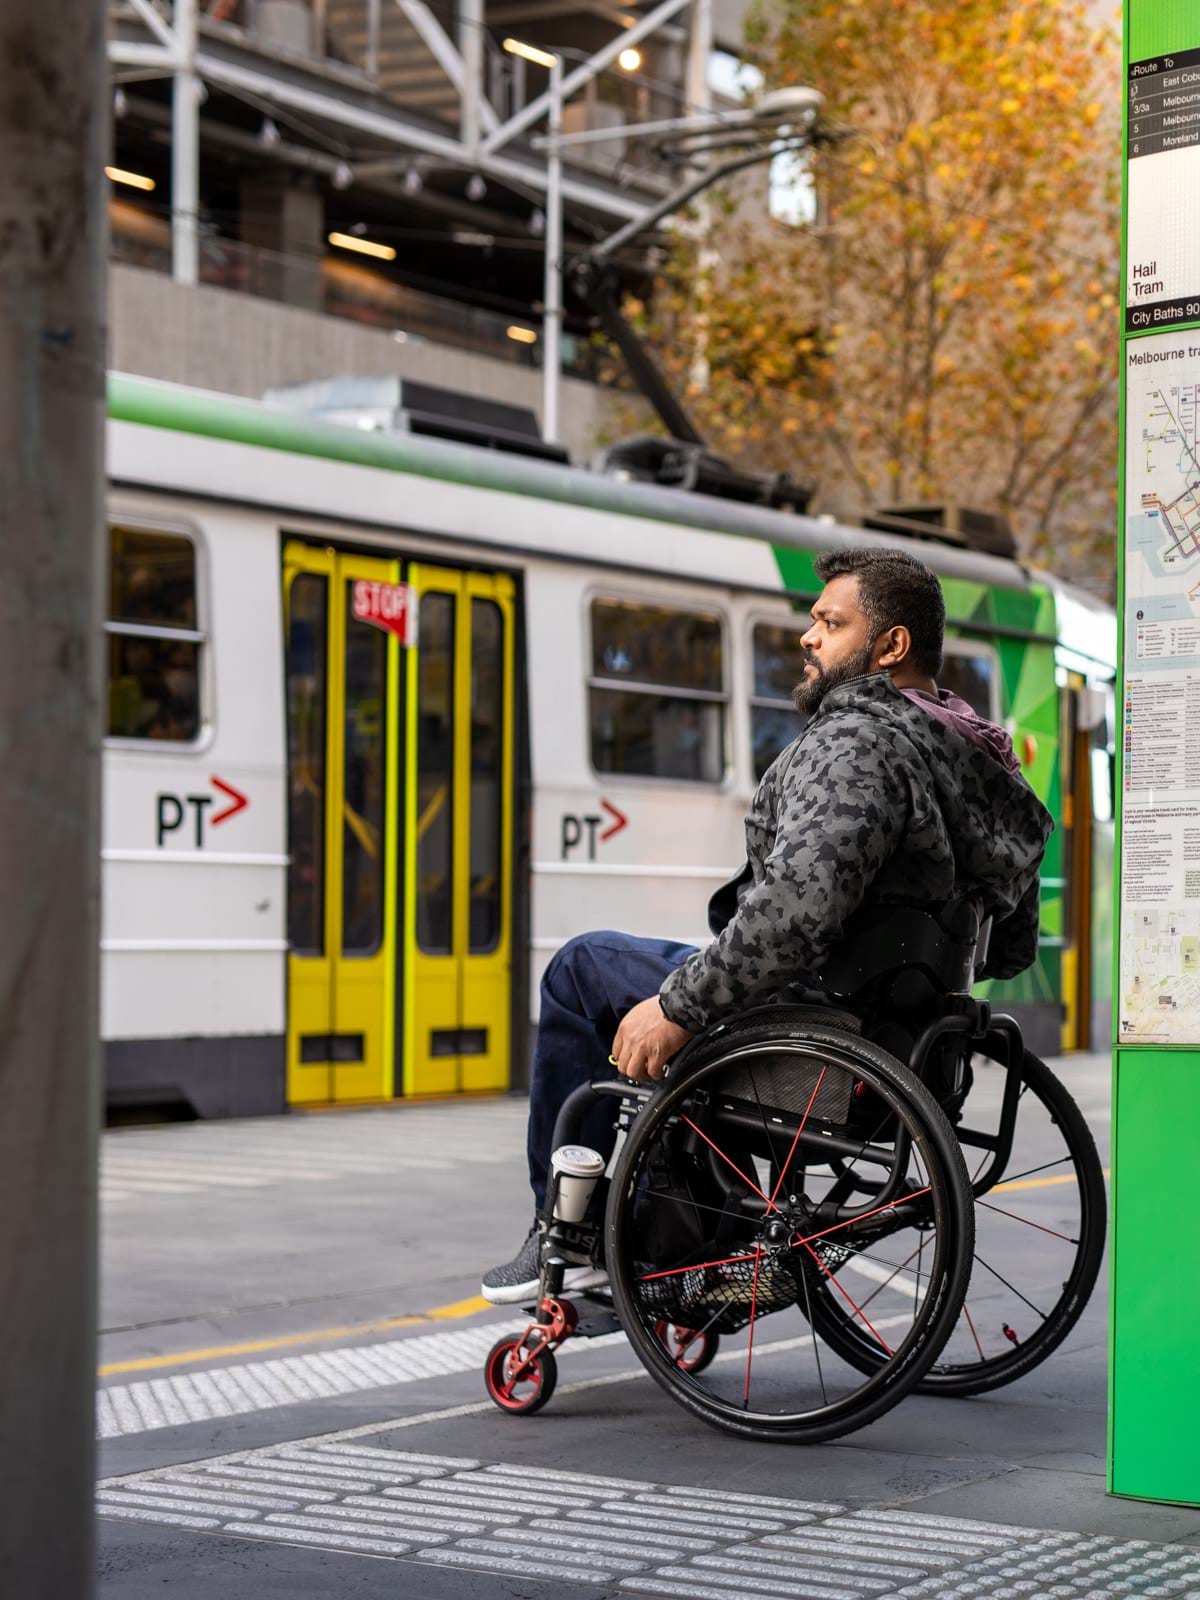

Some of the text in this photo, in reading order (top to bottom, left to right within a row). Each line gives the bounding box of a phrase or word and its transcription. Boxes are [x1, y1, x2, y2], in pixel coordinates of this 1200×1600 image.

[1133, 58, 1175, 76] Route To
[1163, 77, 1180, 87] East
[1134, 104, 1150, 114] 3/3a
[1134, 124, 1139, 133] 5
[1134, 132, 1199, 153] 6 Moreland
[1133, 261, 1157, 278] Hail
[1132, 280, 1164, 297] Tram
[1132, 309, 1151, 326] City
[1153, 304, 1184, 321] Baths
[1129, 347, 1185, 367] Melbourne
[354, 580, 407, 619] STOP
